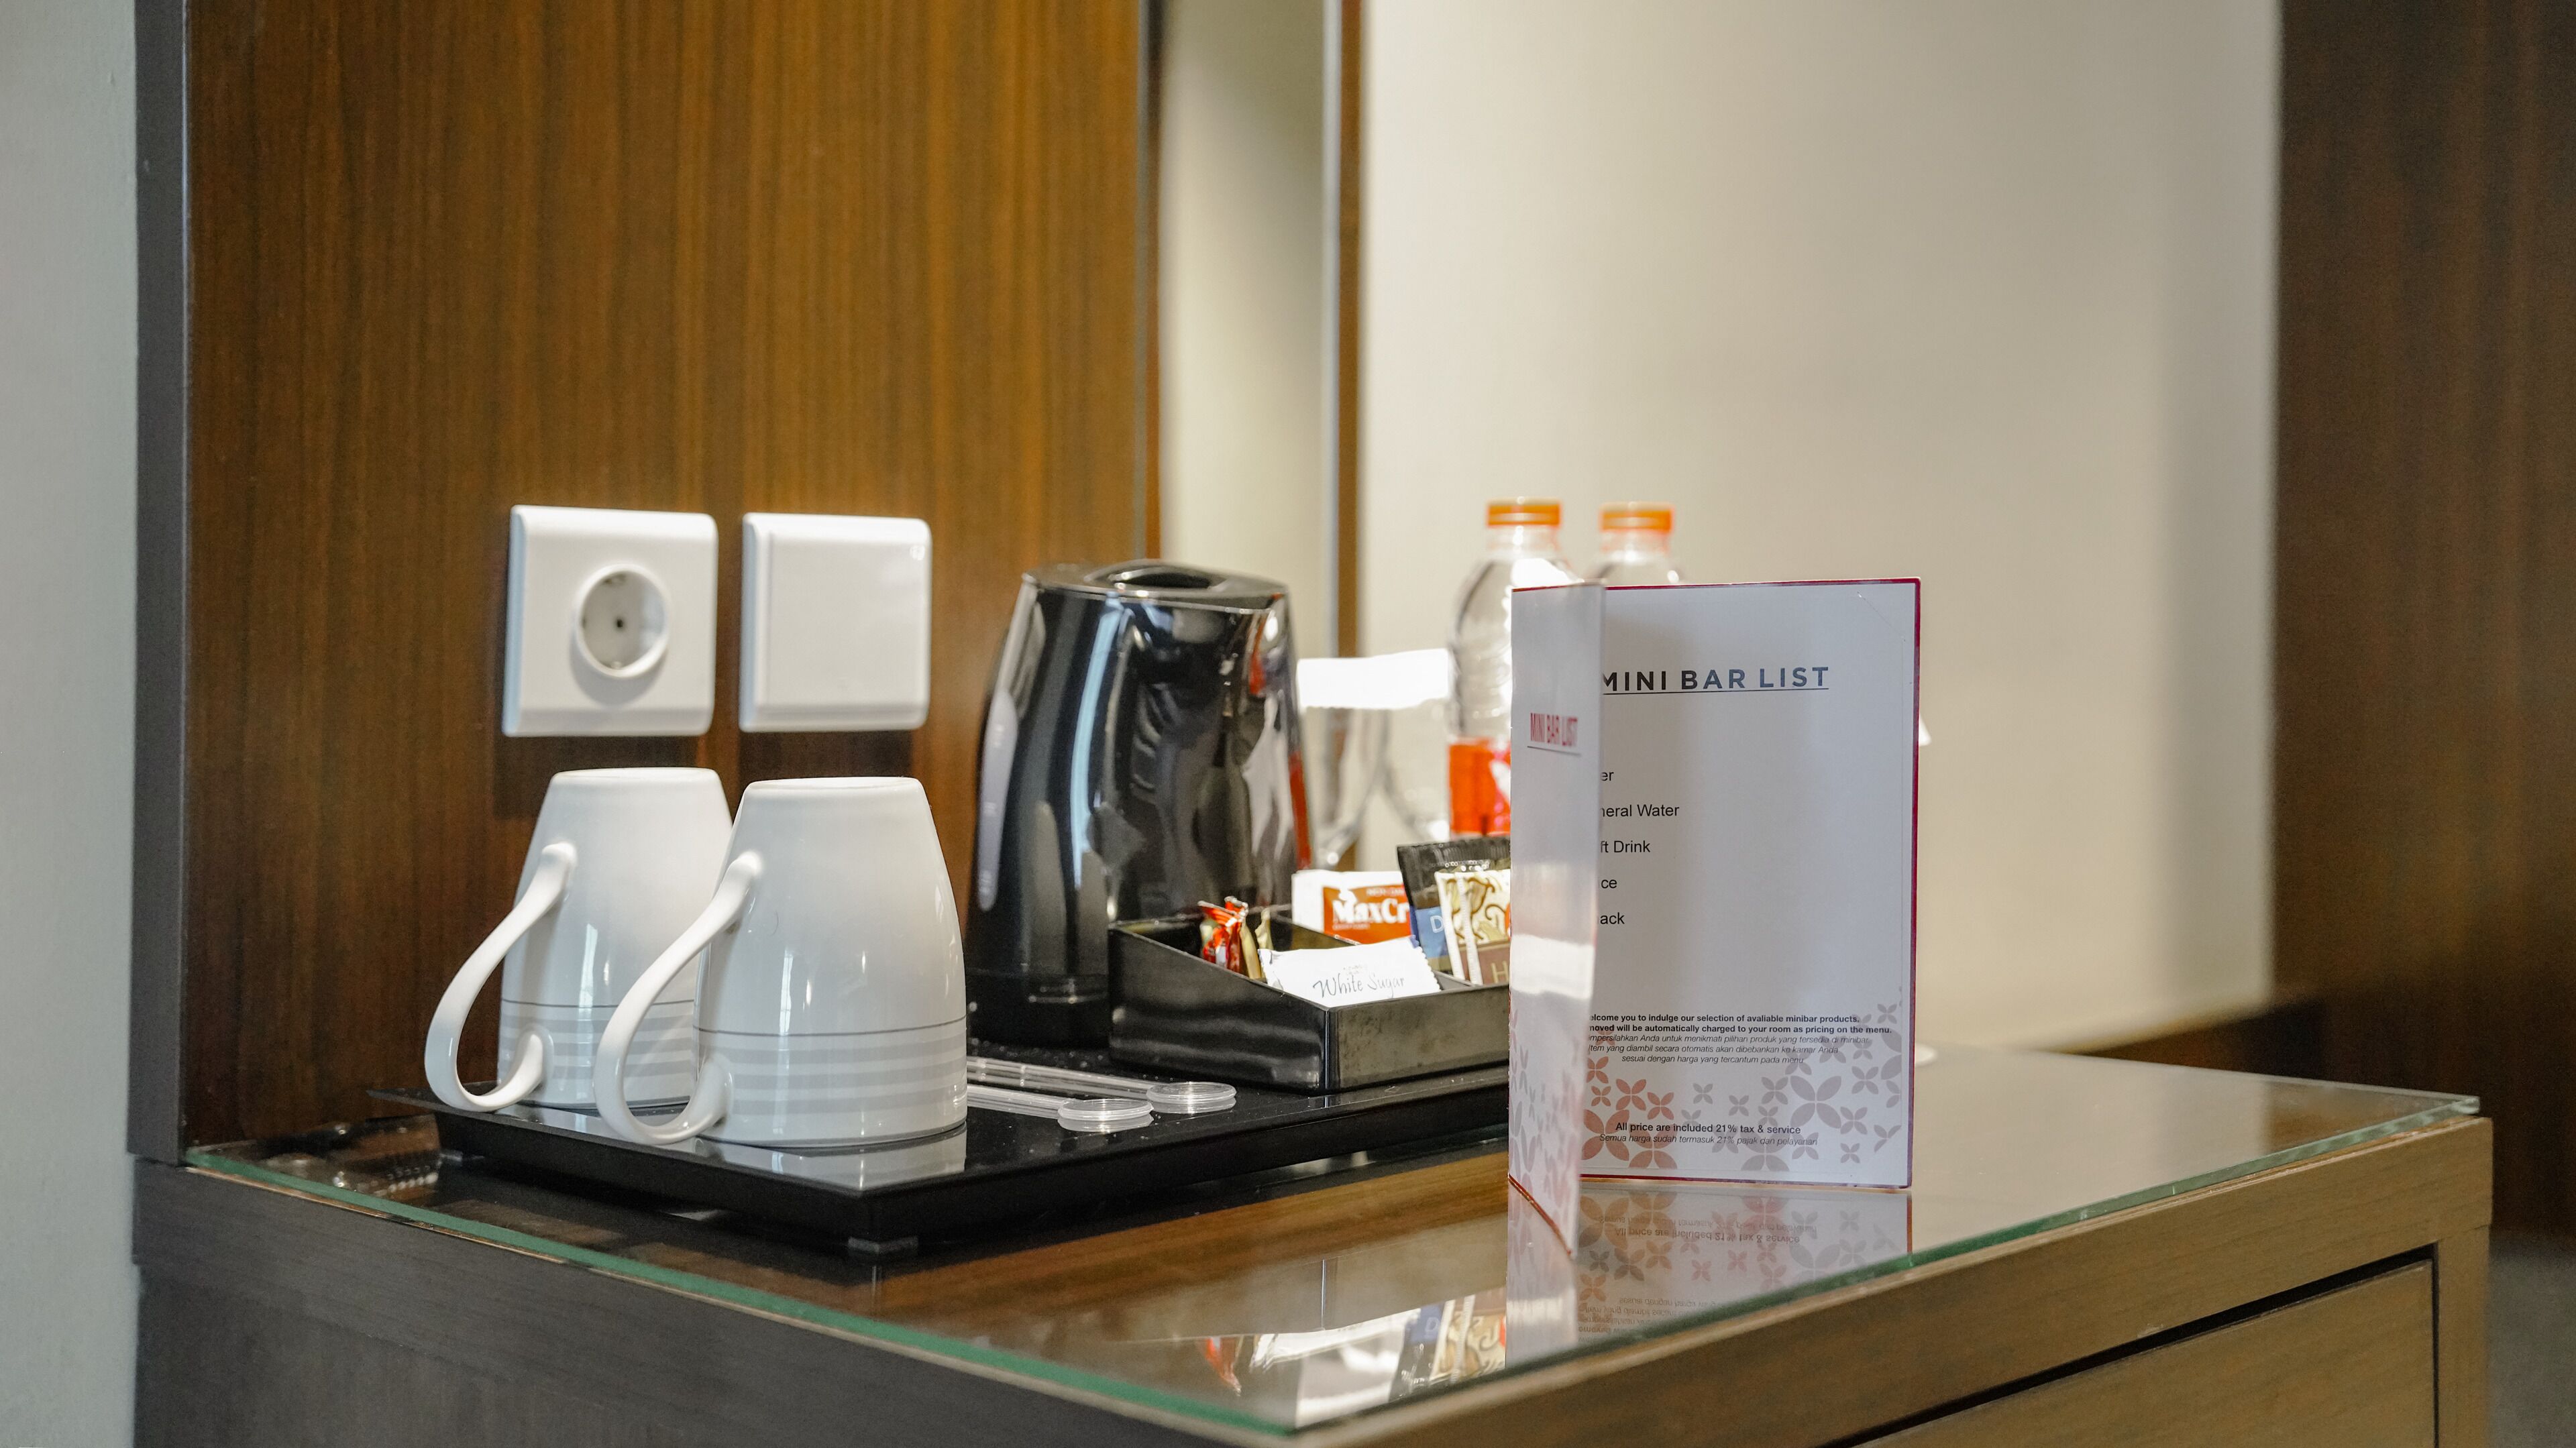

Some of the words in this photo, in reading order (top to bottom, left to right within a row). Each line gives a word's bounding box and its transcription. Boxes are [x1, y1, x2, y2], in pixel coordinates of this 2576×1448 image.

[1603, 671, 1666, 691] MINI
[1681, 669, 1746, 689] BAR
[1760, 667, 1829, 688] LIST
[1530, 712, 1545, 742] MINI
[1546, 714, 1560, 744] BAR
[1601, 772, 1614, 781] er
[1601, 804, 1631, 817] neral
[1637, 804, 1680, 816] Water
[1601, 840, 1609, 853] ft
[1614, 840, 1651, 853] Drink
[1332, 897, 1409, 924] MaxCr
[1600, 911, 1625, 924] ack
[1313, 972, 1363, 998] White
[1367, 972, 1405, 999] Sugar
[1649, 1014, 1678, 1023] indulge
[1819, 1015, 1860, 1023] products.
[1645, 1025, 1699, 1033] automatically
[1701, 1025, 1735, 1034] charged
[1805, 1025, 1835, 1034] pricing
[1589, 1035, 1638, 1043] mpersilahkan
[1724, 1036, 1749, 1044] pilihan
[1750, 1036, 1776, 1044] produk
[1647, 1055, 1675, 1063] dengan
[1677, 1056, 1698, 1064] harga
[1760, 1056, 1780, 1064] pada
[1615, 1123, 1627, 1131] All
[1630, 1123, 1653, 1133] price
[1674, 1123, 1713, 1132] included
[1716, 1125, 1737, 1133] 21%
[1758, 1125, 1764, 1133] &
[1767, 1125, 1801, 1133] service
[1599, 1134, 1626, 1142] Semua
[1629, 1134, 1651, 1144] harga
[1679, 1135, 1714, 1144] termasuk
[1736, 1137, 1758, 1146] pajak
[1777, 1137, 1818, 1146] pelayanan
